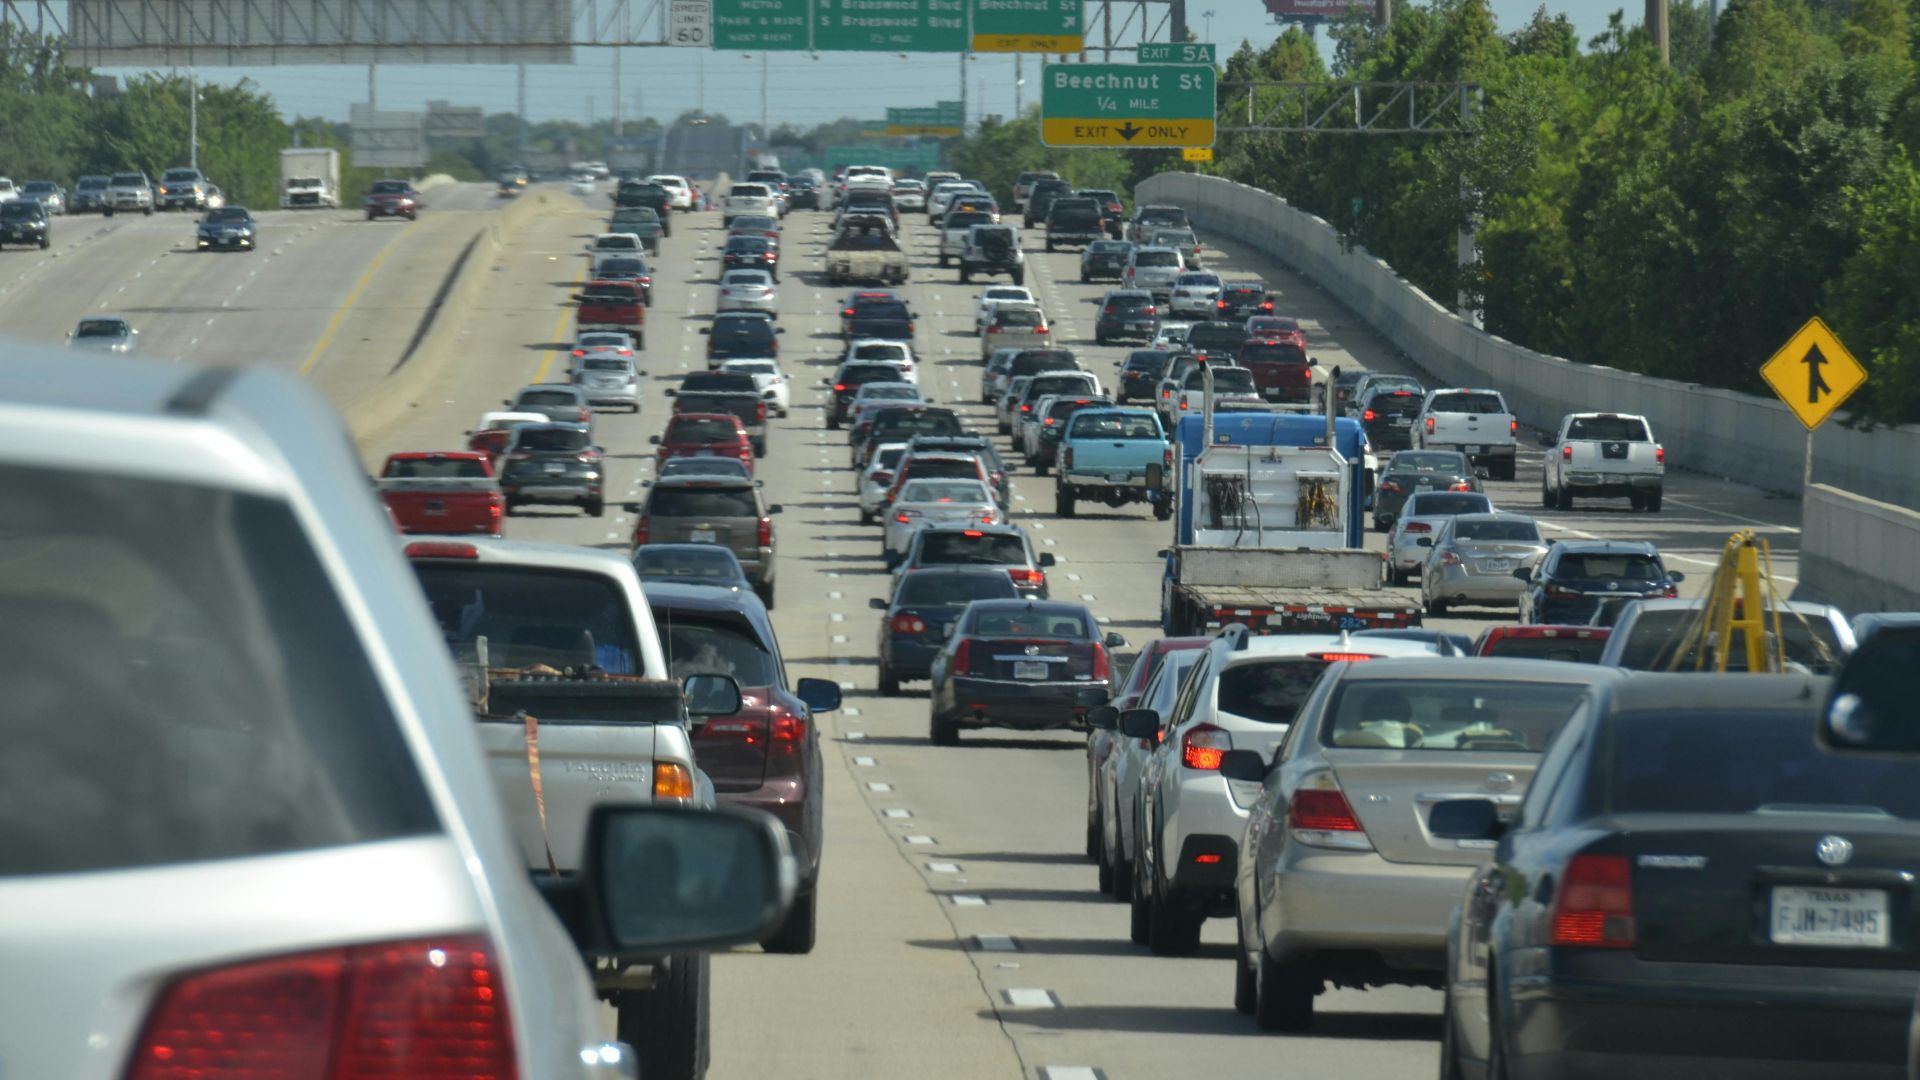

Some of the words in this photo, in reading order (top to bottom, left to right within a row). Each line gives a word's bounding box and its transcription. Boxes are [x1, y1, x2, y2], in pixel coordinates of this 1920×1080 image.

[671, 4, 707, 13] SPEED
[720, 16, 751, 26] PARK
[774, 16, 804, 26] RIDE
[820, 15, 831, 27] S
[677, 27, 704, 43] 60
[1142, 47, 1170, 59] EXIT
[1183, 46, 1211, 62] 5A
[1055, 72, 1160, 89] Beechnut
[1179, 73, 1203, 90] St
[1129, 98, 1160, 109] MILE
[1074, 126, 1109, 138] EXIT
[1148, 126, 1189, 139] ONLY
[1807, 889, 1852, 903] TEXAS
